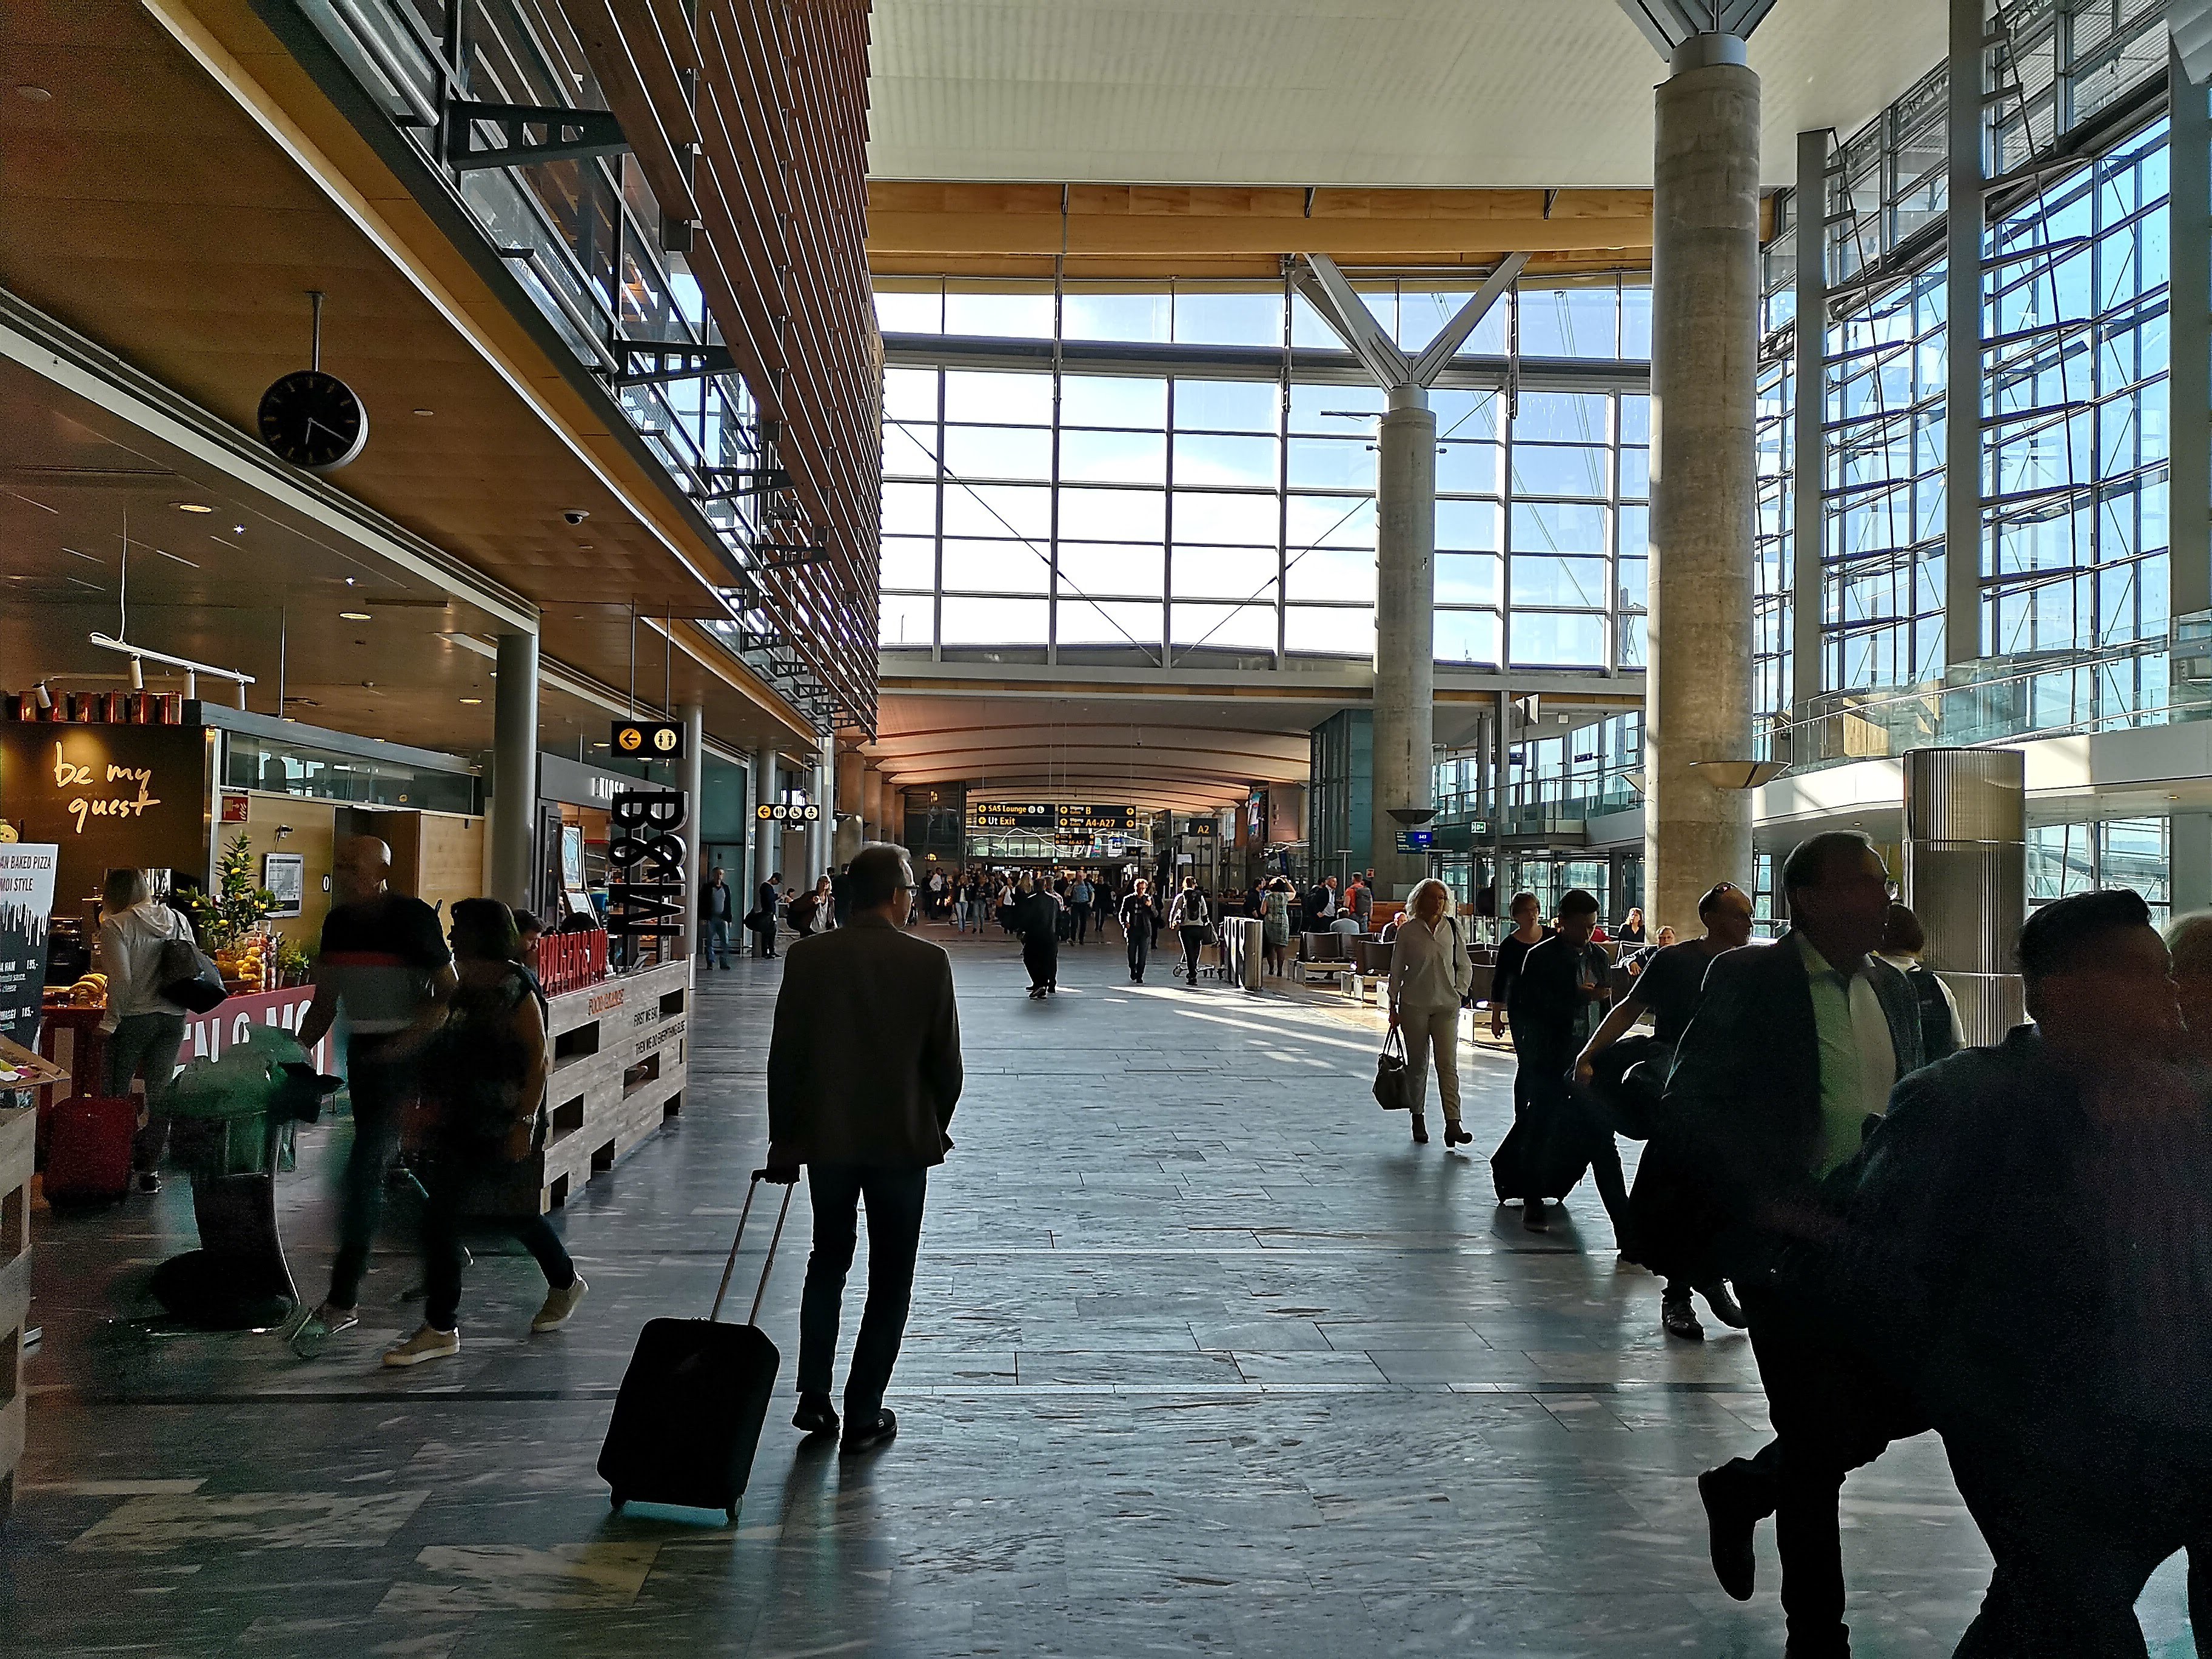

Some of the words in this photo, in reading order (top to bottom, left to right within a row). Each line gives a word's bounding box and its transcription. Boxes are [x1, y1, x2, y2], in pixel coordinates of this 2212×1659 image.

[54, 741, 94, 788] be
[107, 764, 152, 796] my
[1002, 805, 1027, 814] Lounge
[1085, 806, 1091, 815] B
[988, 816, 998, 825] Ut
[1000, 817, 1016, 825] Exit
[1085, 819, 1115, 828] A4-A27
[1197, 825, 1210, 834] A2
[10, 856, 32, 869] BAKED
[33, 856, 51, 869] PIZZA
[13, 878, 33, 891] STYLE
